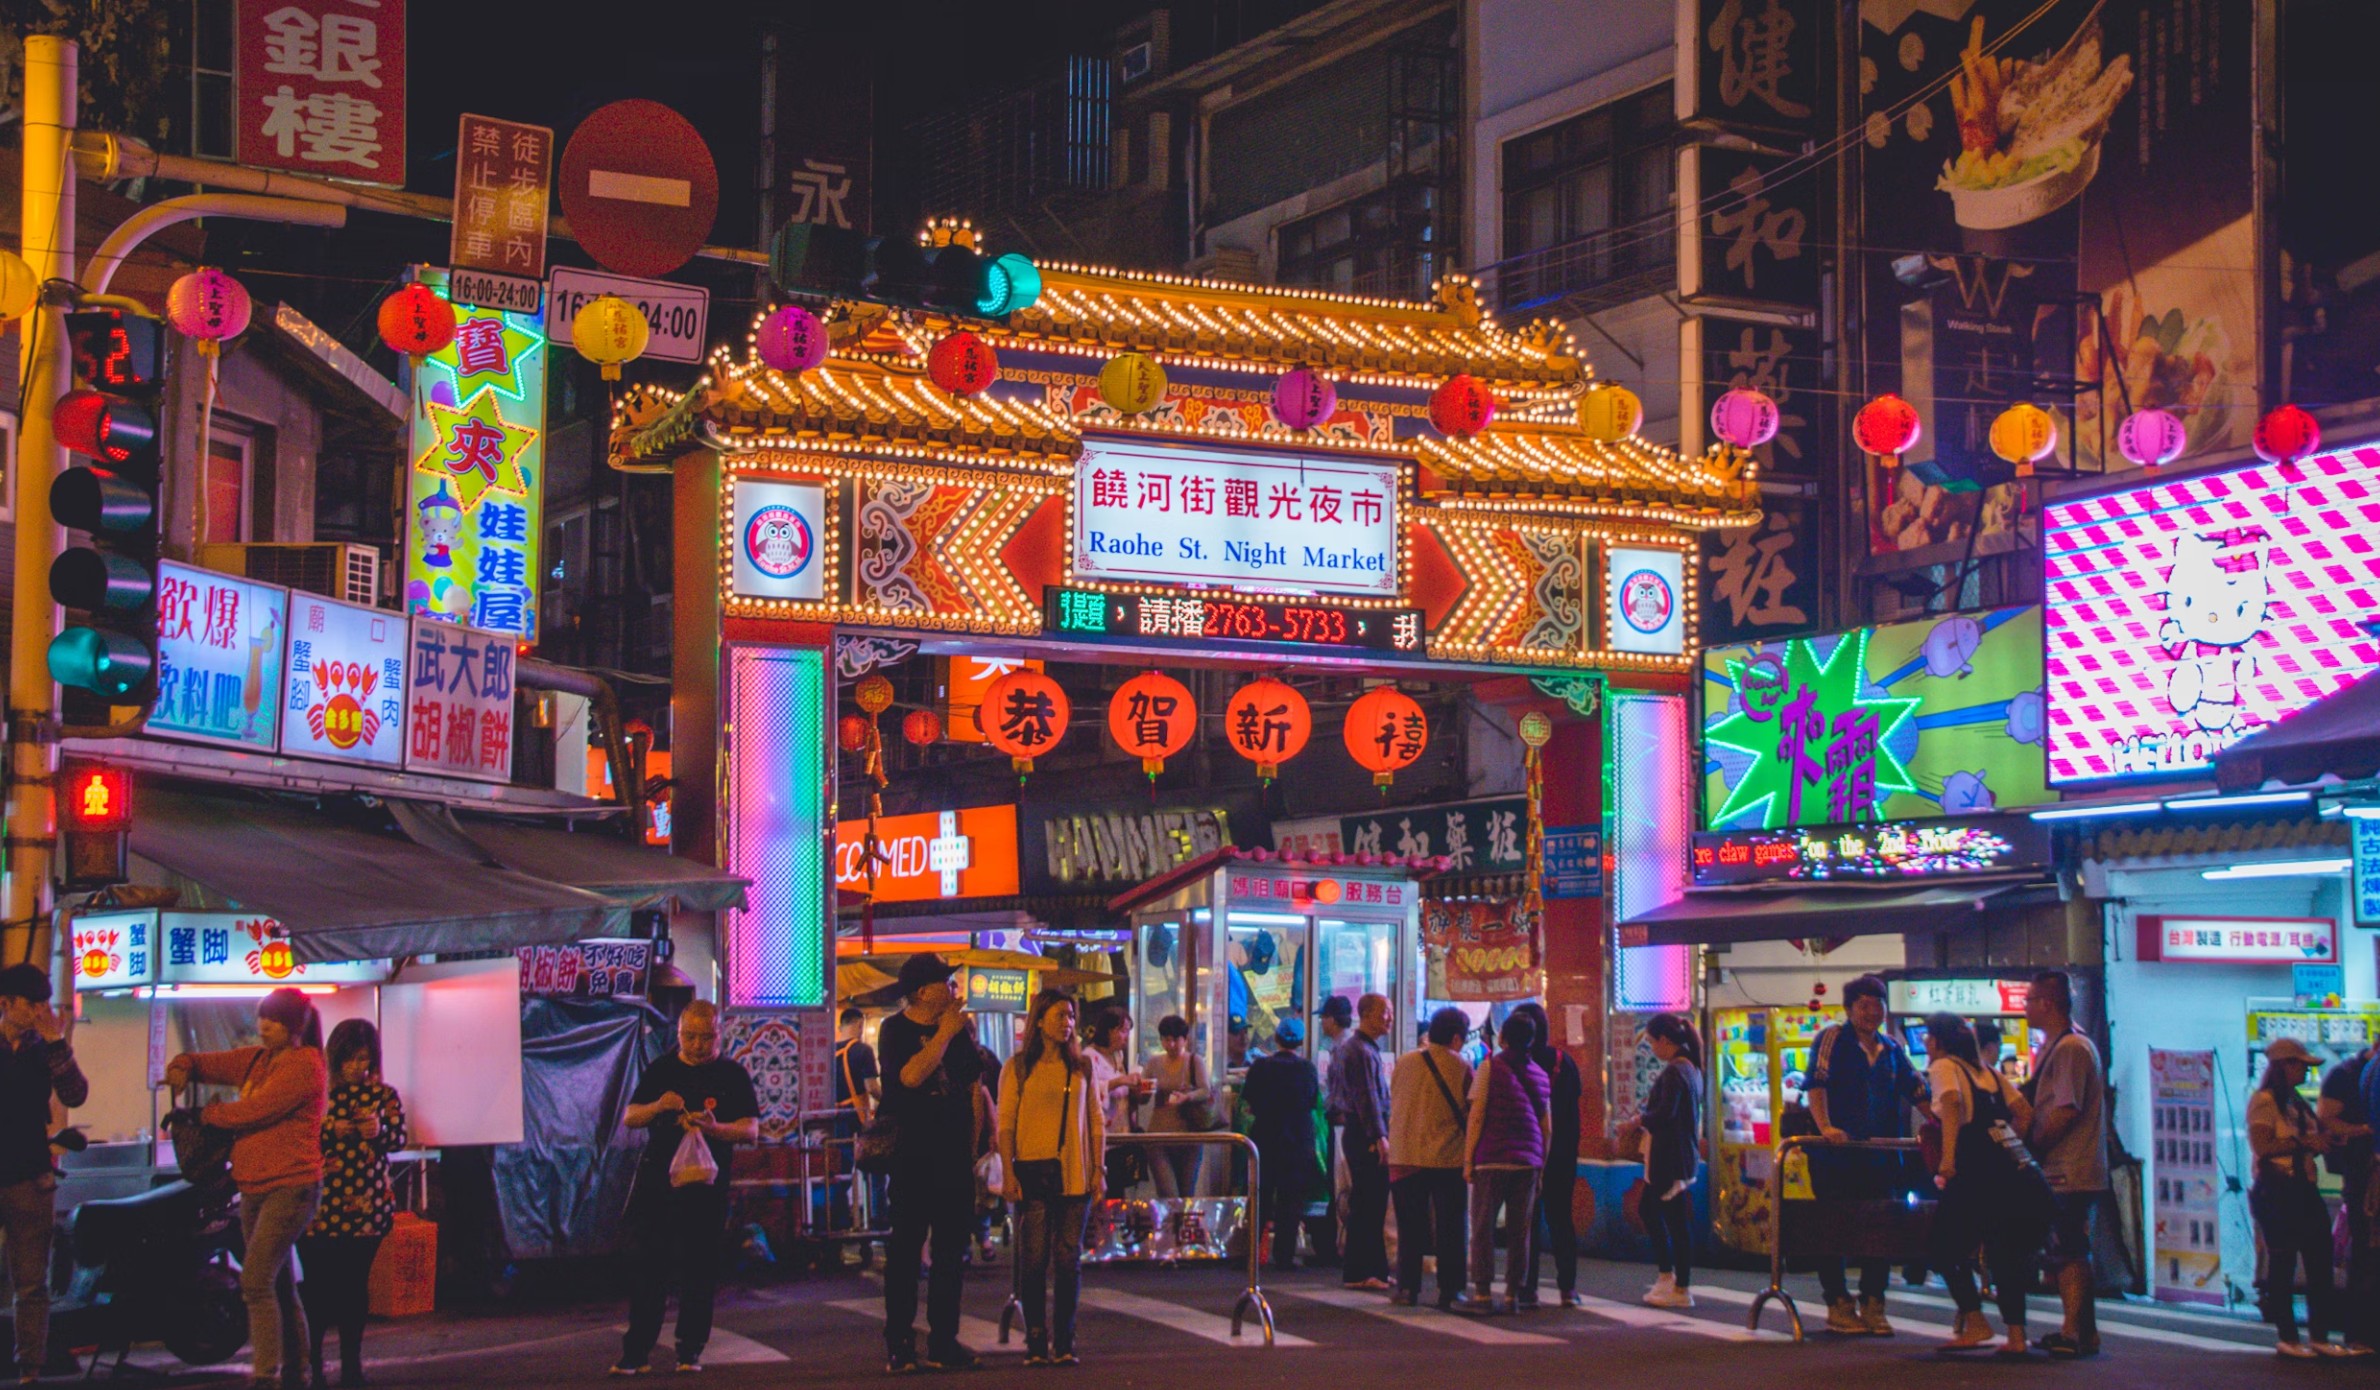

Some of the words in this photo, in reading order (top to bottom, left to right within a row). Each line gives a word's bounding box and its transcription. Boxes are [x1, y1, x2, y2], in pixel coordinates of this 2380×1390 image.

[467, 125, 501, 260] 禁止停車
[506, 132, 541, 268] 徒步區內
[791, 158, 852, 230] 永
[456, 275, 536, 309] 16:00-24:00
[1092, 467, 1385, 527] 饒河街觀光夜市
[476, 501, 527, 631] 娃娃屋
[1089, 531, 1163, 557] Raohe
[1179, 536, 1208, 560] St.
[1224, 540, 1287, 569] Night
[1303, 546, 1386, 572] Market
[413, 627, 511, 702] 武大郎
[412, 696, 510, 772] 胡椒餅
[1000, 688, 1056, 746] 恭
[1127, 690, 1179, 748] 賀
[1236, 703, 1291, 754] 新
[1718, 840, 1750, 863] claw
[1840, 834, 1864, 857] the
[1346, 881, 1403, 904] 服務台
[585, 944, 646, 969] 不好吃
